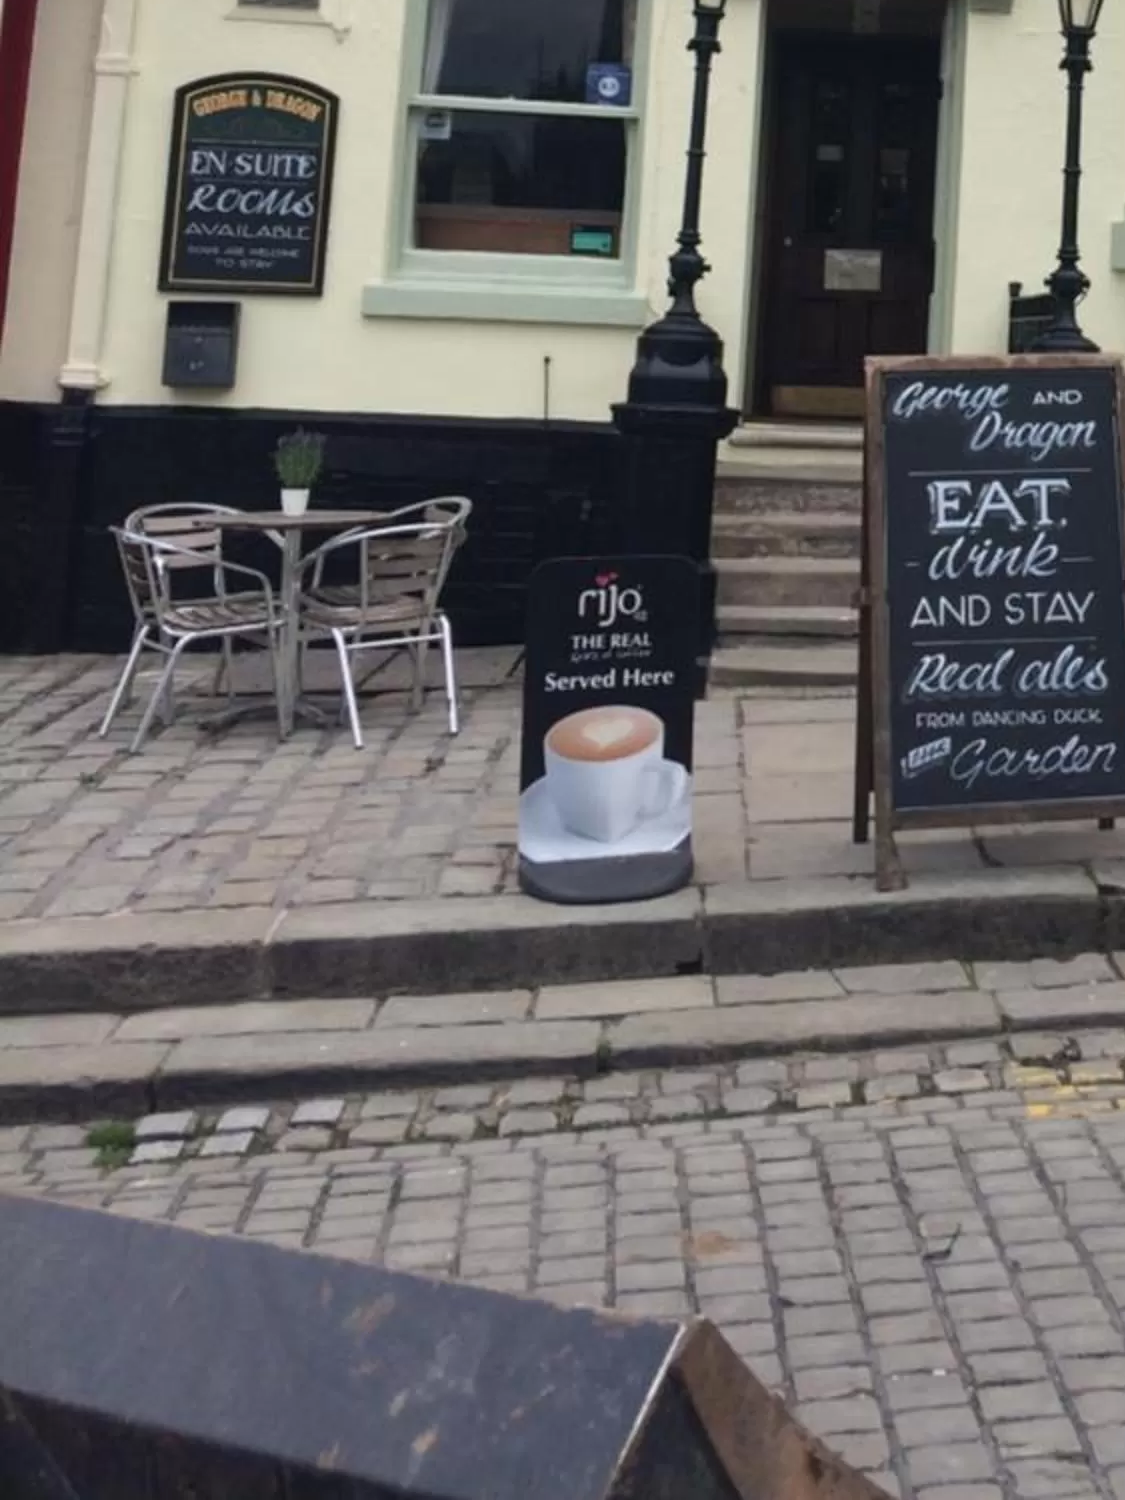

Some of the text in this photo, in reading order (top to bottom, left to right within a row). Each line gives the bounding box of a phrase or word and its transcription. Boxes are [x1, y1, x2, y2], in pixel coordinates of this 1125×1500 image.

[190, 150, 317, 179] EN SUITE
[185, 221, 312, 240] AVAILABLE
[892, 381, 1083, 420] George AND
[970, 410, 1097, 462] Dragon
[928, 532, 1059, 580] drink
[579, 573, 643, 628] rijo
[910, 591, 1095, 628] AND STAY
[571, 631, 653, 650] THE REAL
[544, 668, 675, 692] Served Here
[908, 644, 1109, 695] Real ales
[915, 711, 966, 729] FROM
[972, 709, 1047, 727] DANCING
[950, 734, 1118, 789] Garden
